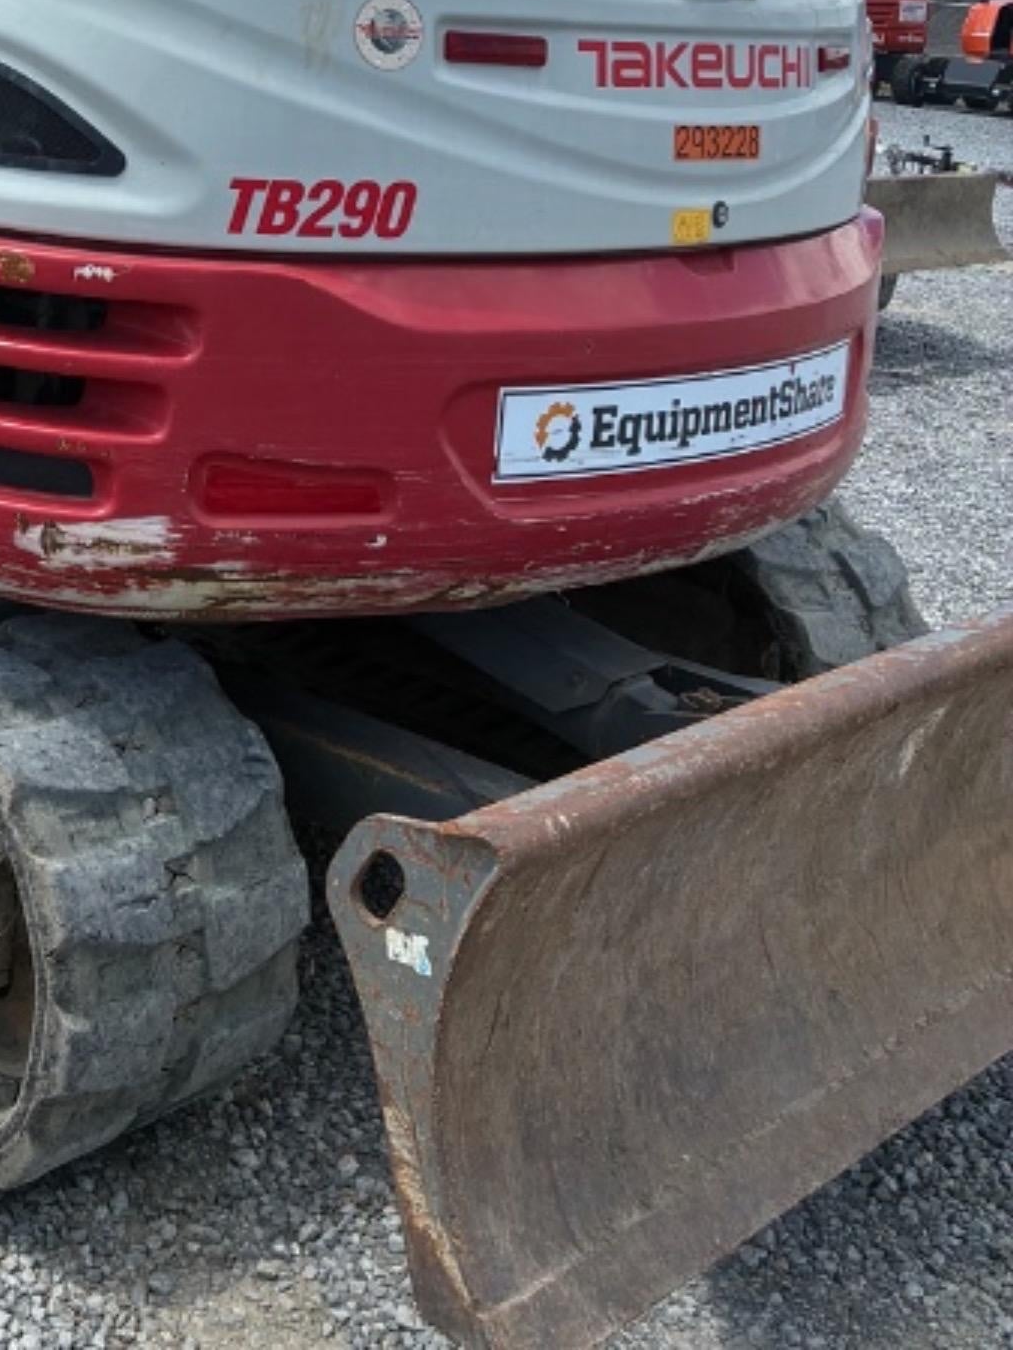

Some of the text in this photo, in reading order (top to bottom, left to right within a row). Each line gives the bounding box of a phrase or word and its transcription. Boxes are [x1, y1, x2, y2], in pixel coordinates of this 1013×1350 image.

[675, 126, 759, 159] 293228
[227, 178, 417, 238] TB290
[590, 371, 836, 455] EquipmentShare
